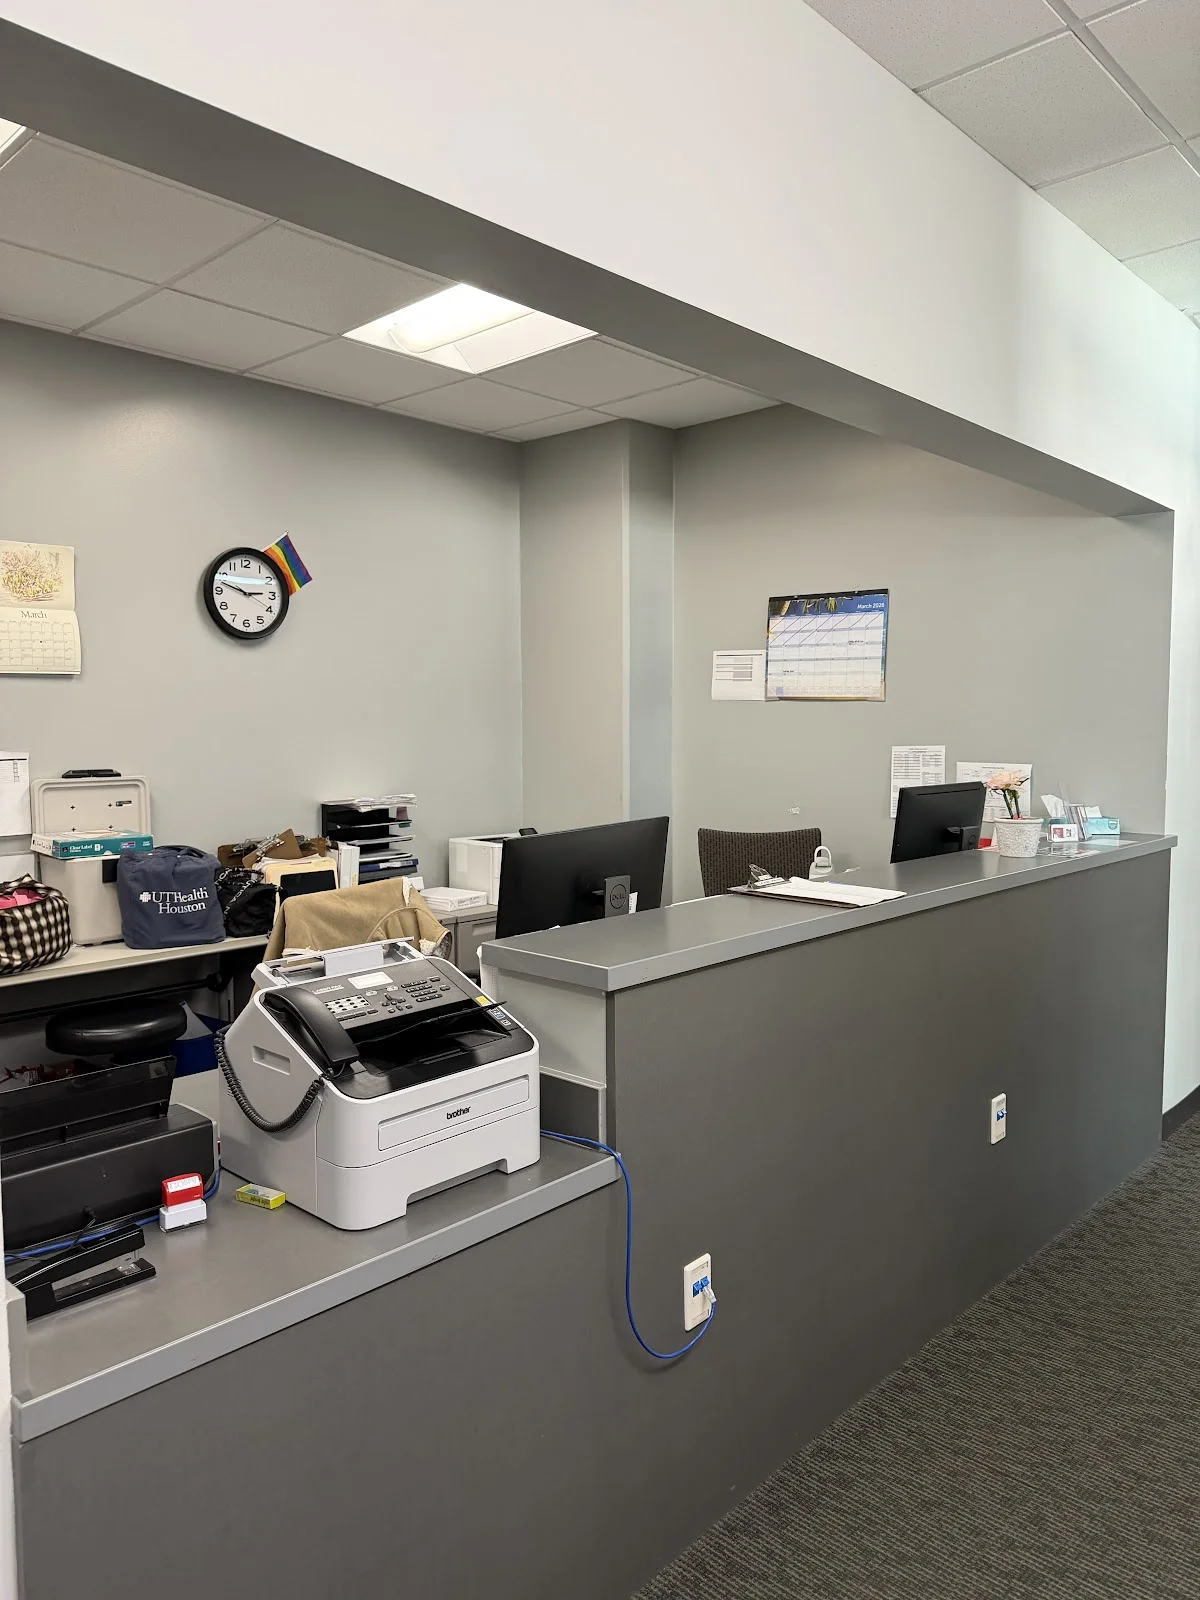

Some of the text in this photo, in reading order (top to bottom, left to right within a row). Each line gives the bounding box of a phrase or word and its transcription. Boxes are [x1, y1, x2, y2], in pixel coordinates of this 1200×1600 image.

[229, 562, 236, 571] 11
[241, 559, 251, 569] 12
[265, 576, 273, 585] 2
[215, 586, 223, 595] 9
[268, 591, 276, 600] 3
[219, 601, 228, 610] 8
[265, 605, 273, 613] 4
[21, 610, 48, 618] March
[230, 613, 237, 622] 7
[242, 619, 251, 628] 6
[256, 616, 265, 625] 5
[152, 888, 209, 902] UTHealth
[158, 902, 206, 914] Houston
[446, 1106, 471, 1120] brother
